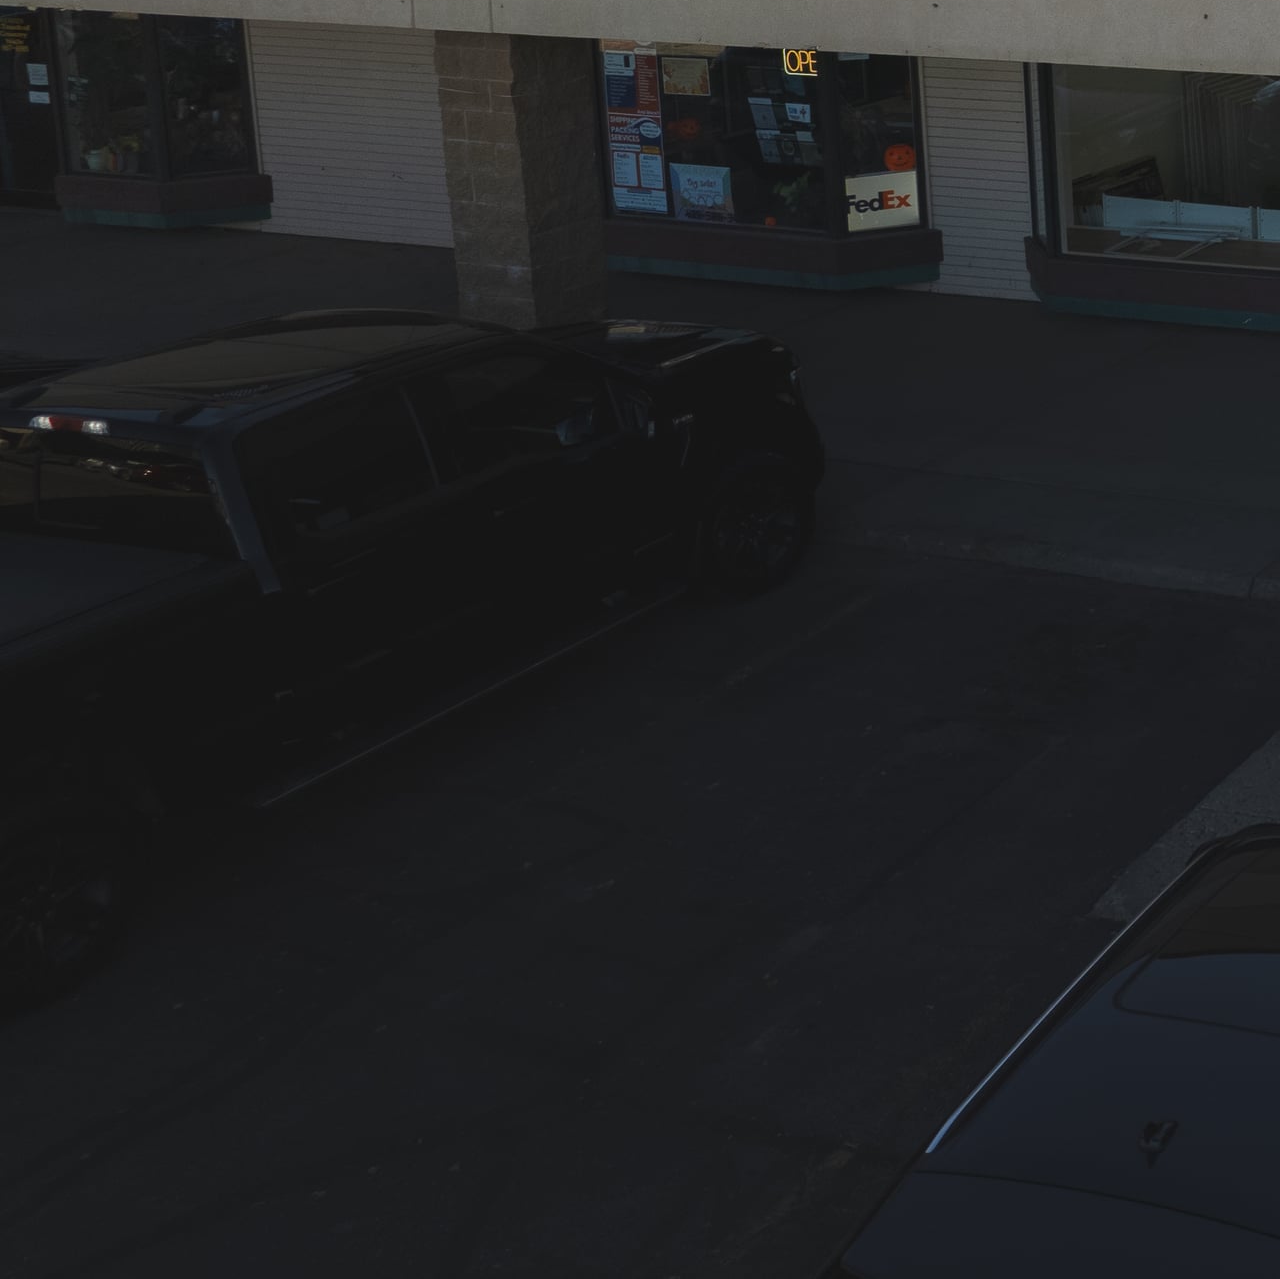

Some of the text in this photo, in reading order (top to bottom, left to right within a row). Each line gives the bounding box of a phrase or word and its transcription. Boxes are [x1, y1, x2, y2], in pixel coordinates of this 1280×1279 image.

[786, 49, 818, 73] OPE
[610, 133, 641, 143] SERVICES
[847, 189, 912, 214] FedEx
